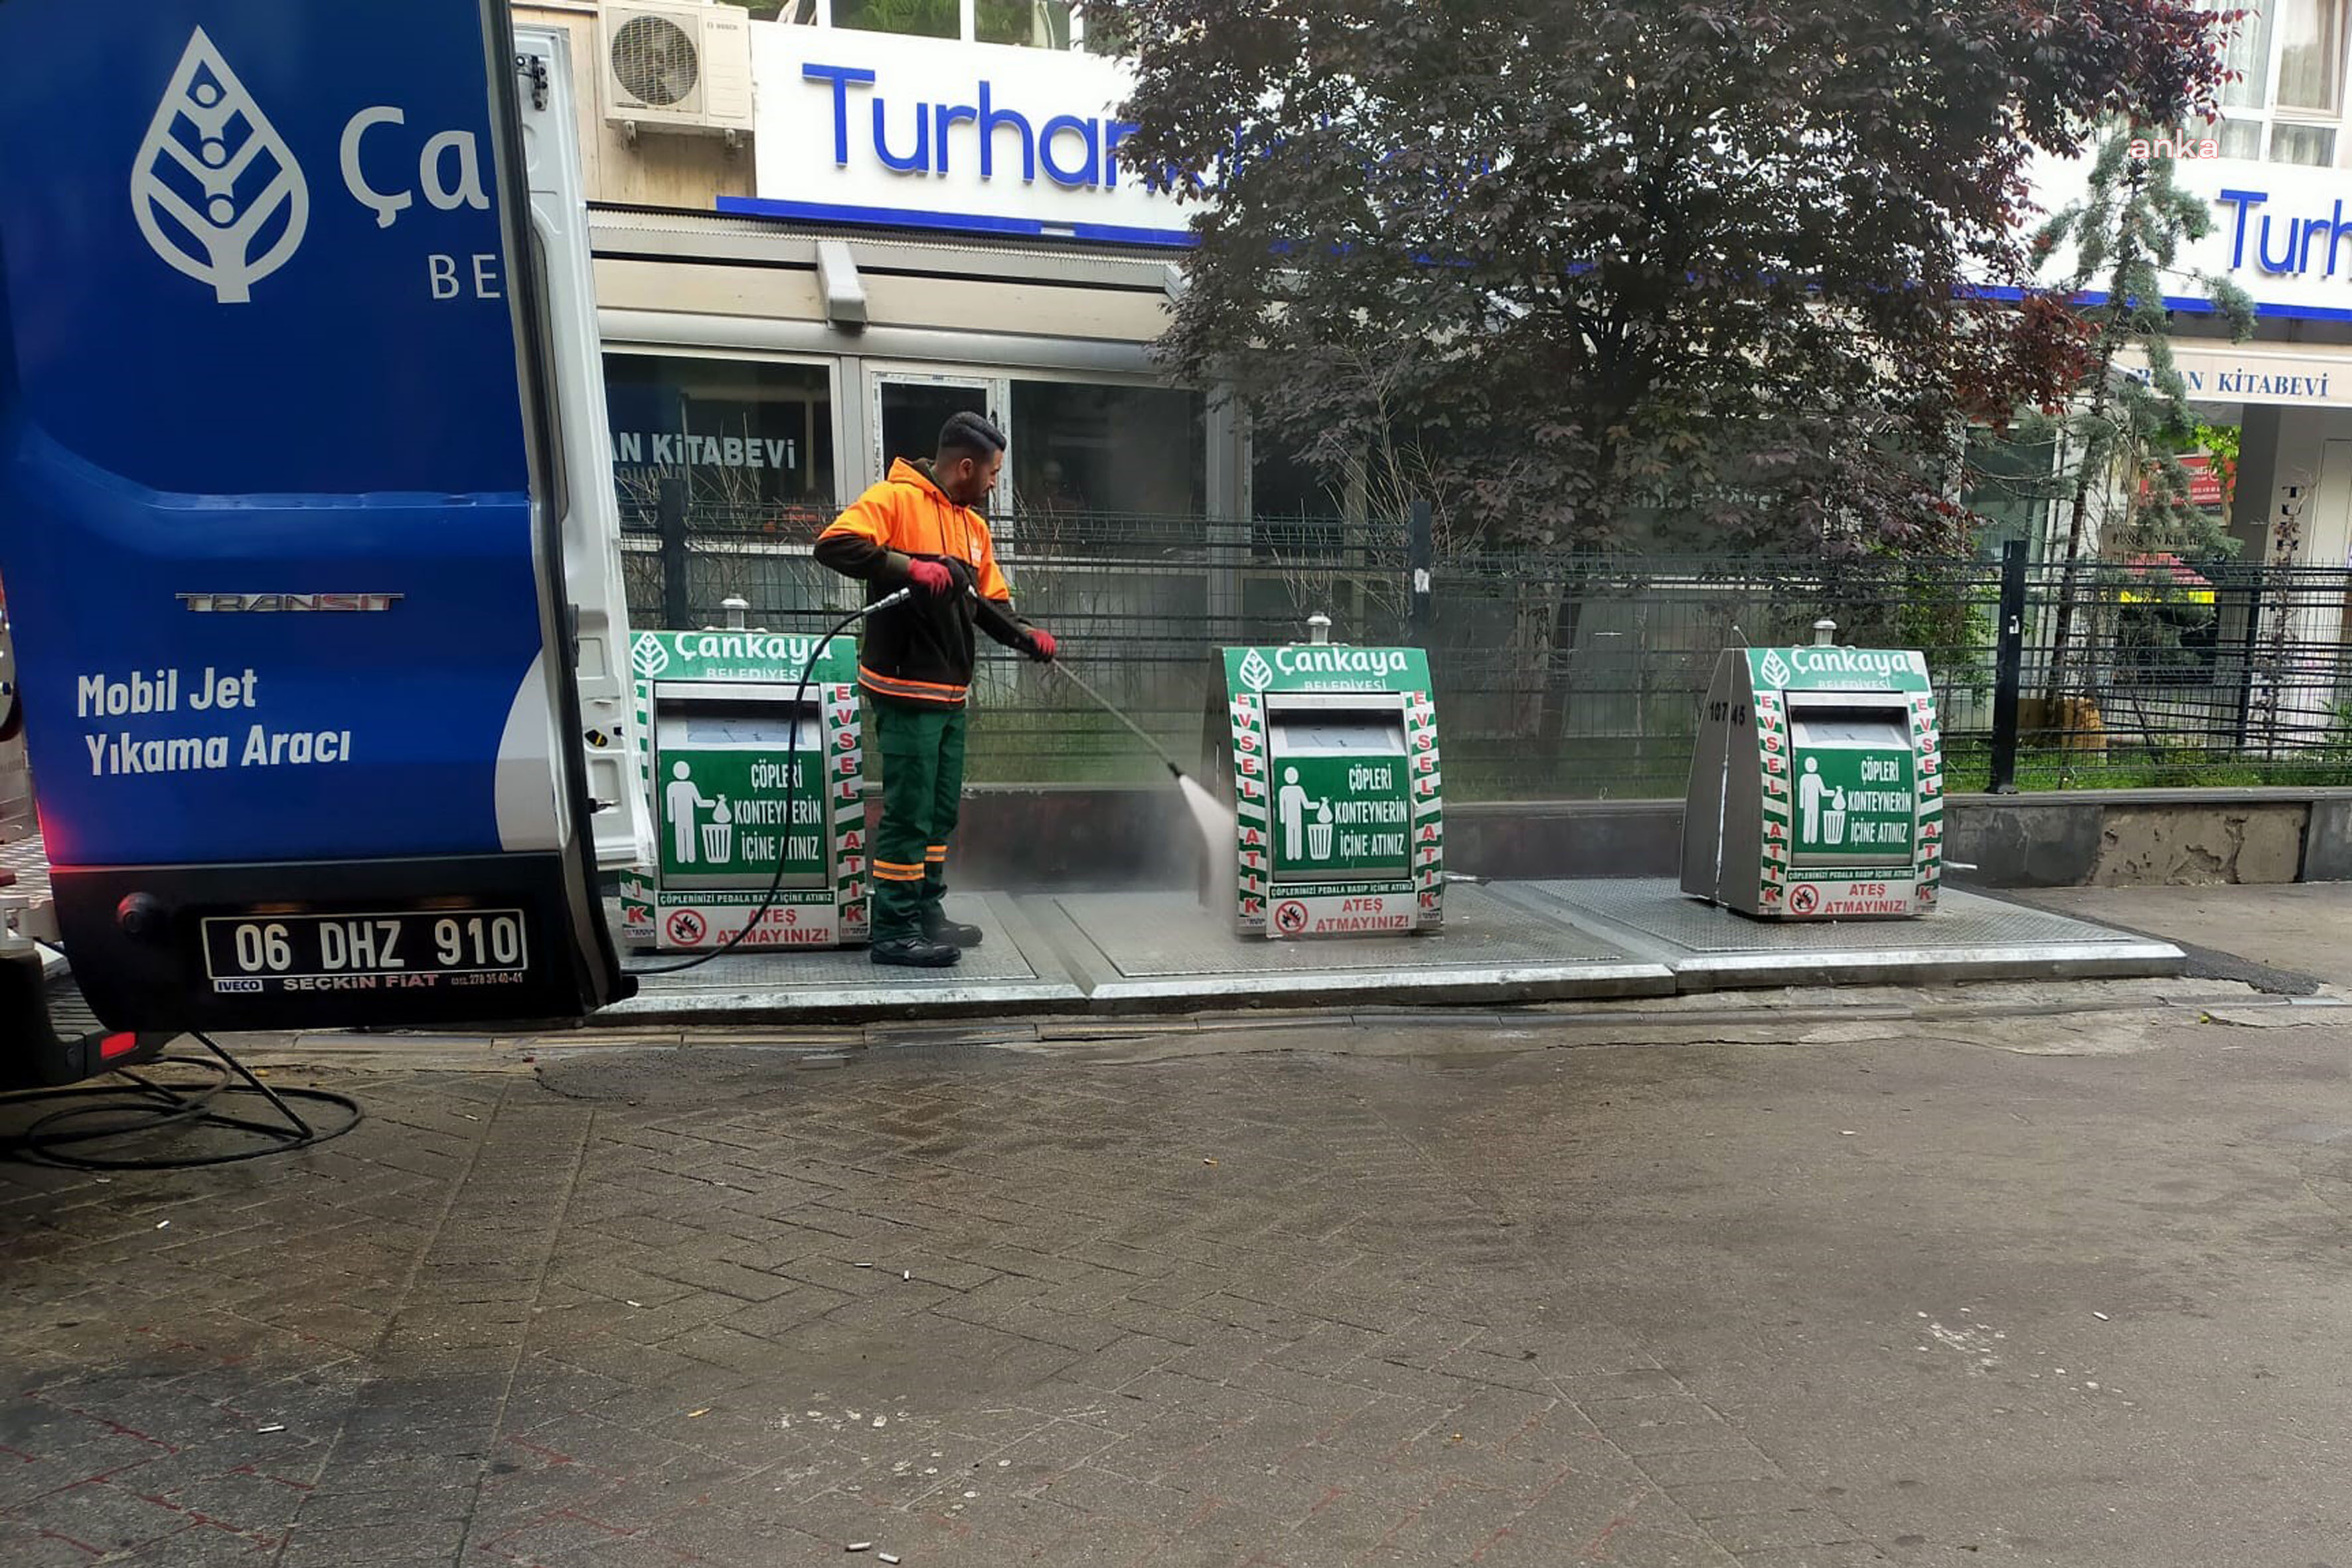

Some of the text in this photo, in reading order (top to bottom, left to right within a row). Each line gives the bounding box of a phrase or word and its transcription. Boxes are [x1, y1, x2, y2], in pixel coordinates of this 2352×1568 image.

[2218, 368, 2329, 396] KİTABEVİ
[175, 593, 404, 612] TRANSIT
[674, 631, 832, 665] Çankaya
[1275, 647, 1408, 676] Çankaya
[1790, 649, 1909, 676] Çankaya
[78, 667, 257, 717] Mobil Jet
[86, 724, 351, 775] Yıkama Aracı
[1349, 763, 1392, 793] ÇÖPLERİ
[1861, 757, 1899, 784] ÇÖPLERİ
[1335, 797, 1407, 823] KONTEYNERİN
[1848, 788, 1911, 813] KONTEYNERİN
[1851, 818, 1907, 844] İÇİNE ATINIZ
[742, 831, 776, 864] İÇİNE
[1340, 832, 1404, 861] İÇİNE ATINIZ
[1849, 884, 1887, 898] ATEŞ
[1342, 898, 1383, 913] ATEŞ
[1825, 900, 1907, 913] ATMAYINIZ!
[1315, 915, 1409, 931] ATMAYINIZ!
[236, 916, 518, 971] 06 DHZ 910
[217, 980, 260, 992] IVECO
